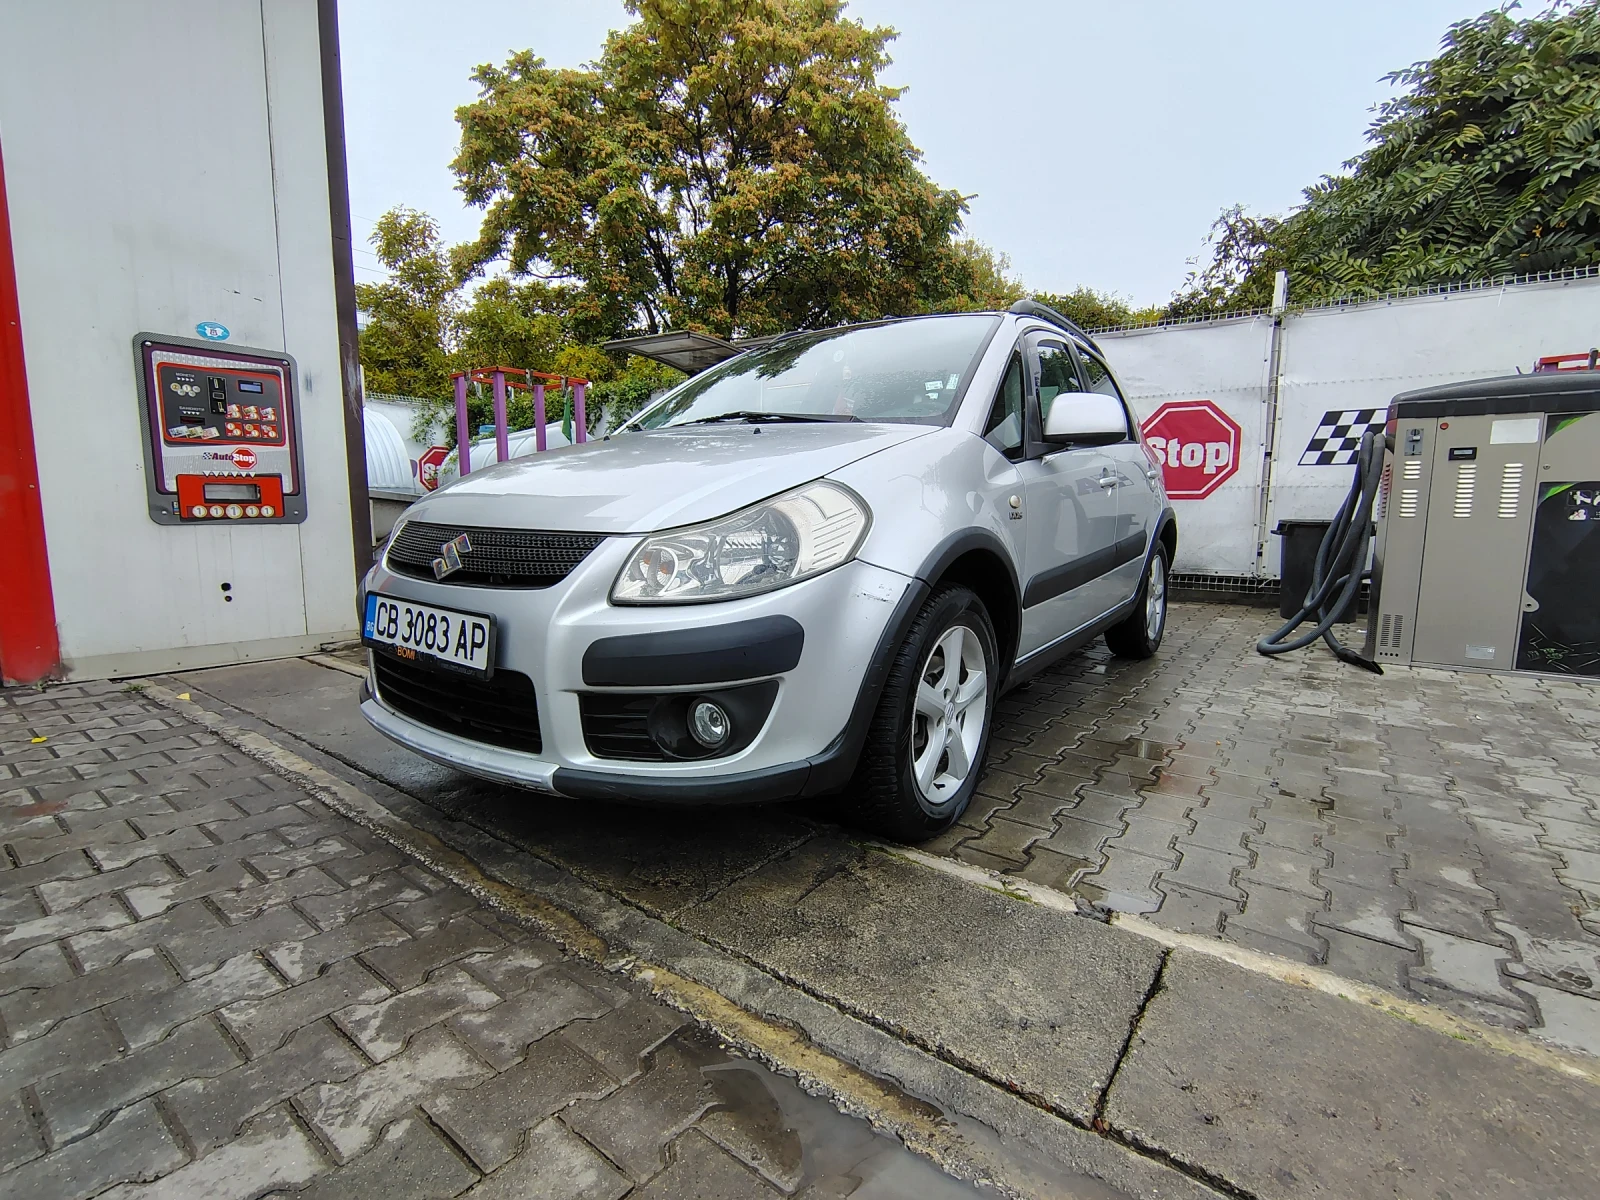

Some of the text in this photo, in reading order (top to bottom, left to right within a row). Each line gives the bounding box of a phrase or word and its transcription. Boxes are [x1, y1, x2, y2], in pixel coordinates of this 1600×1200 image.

[1146, 436, 1230, 475] Stop
[366, 620, 375, 632] BG
[376, 601, 486, 661] CB 3083 AP
